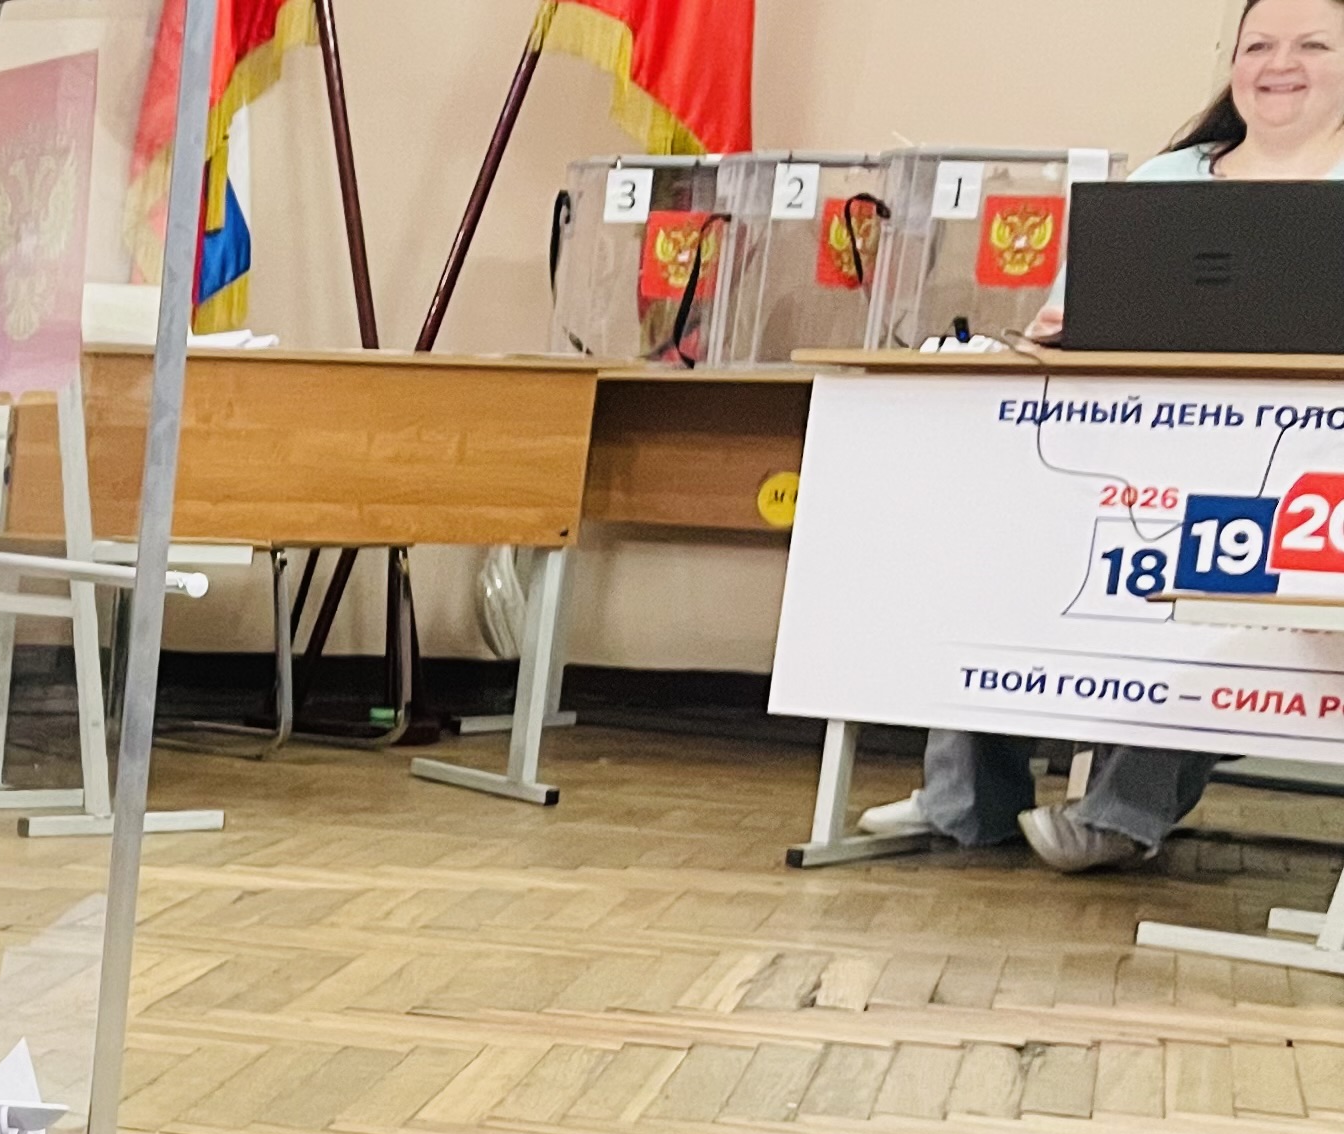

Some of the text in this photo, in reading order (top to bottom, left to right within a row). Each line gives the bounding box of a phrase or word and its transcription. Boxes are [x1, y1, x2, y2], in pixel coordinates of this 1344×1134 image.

[617, 180, 636, 210] 3
[785, 177, 804, 209] 2
[953, 177, 963, 208] 1
[998, 395, 1344, 431] ЕДИНЫЙ ДЕНЬ ГОЛО
[1100, 485, 1179, 510] 2026
[1190, 518, 1264, 576] 19
[1101, 547, 1167, 598] 18
[961, 667, 1047, 695] ТВОЙ
[1056, 675, 1170, 705] ГОЛОС
[1211, 686, 1308, 717] СИЛА
[1318, 694, 1344, 719] Р
